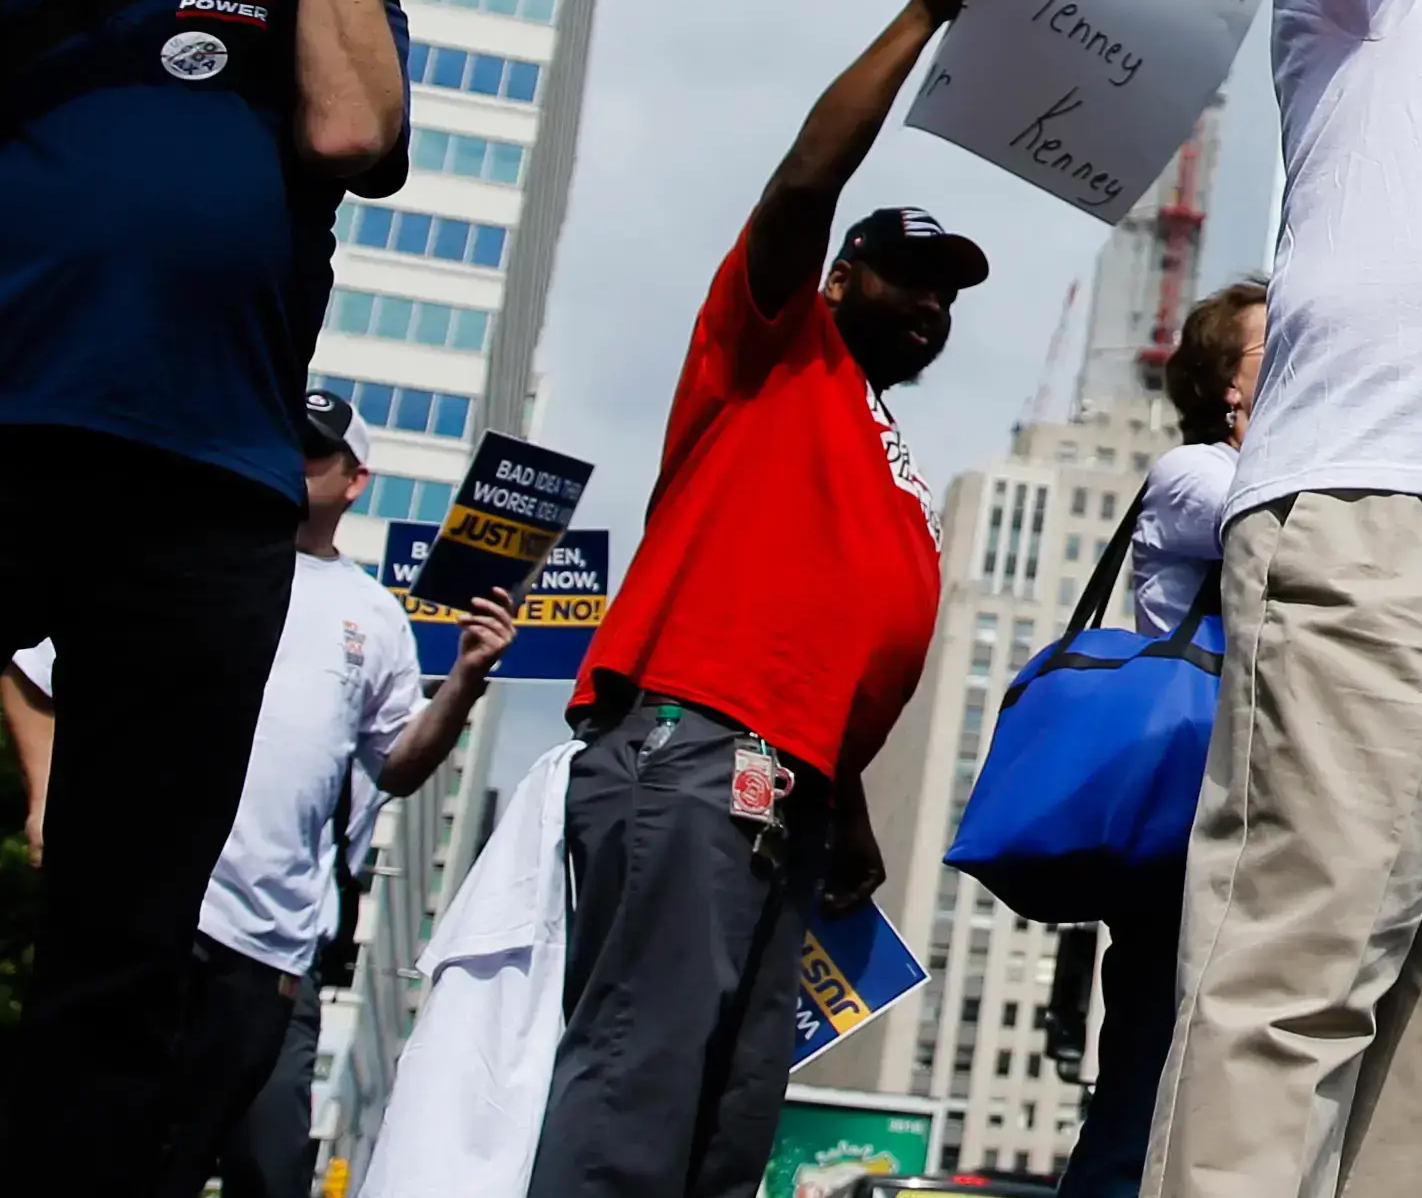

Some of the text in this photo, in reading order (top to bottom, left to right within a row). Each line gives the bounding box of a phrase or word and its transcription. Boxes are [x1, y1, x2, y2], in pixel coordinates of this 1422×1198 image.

[1009, 86, 1124, 206] Kenney
[496, 459, 534, 486] BAD
[473, 480, 538, 517] WORSE
[450, 513, 517, 549] JUST
[541, 571, 600, 592] NOW,
[551, 599, 600, 621] NO!
